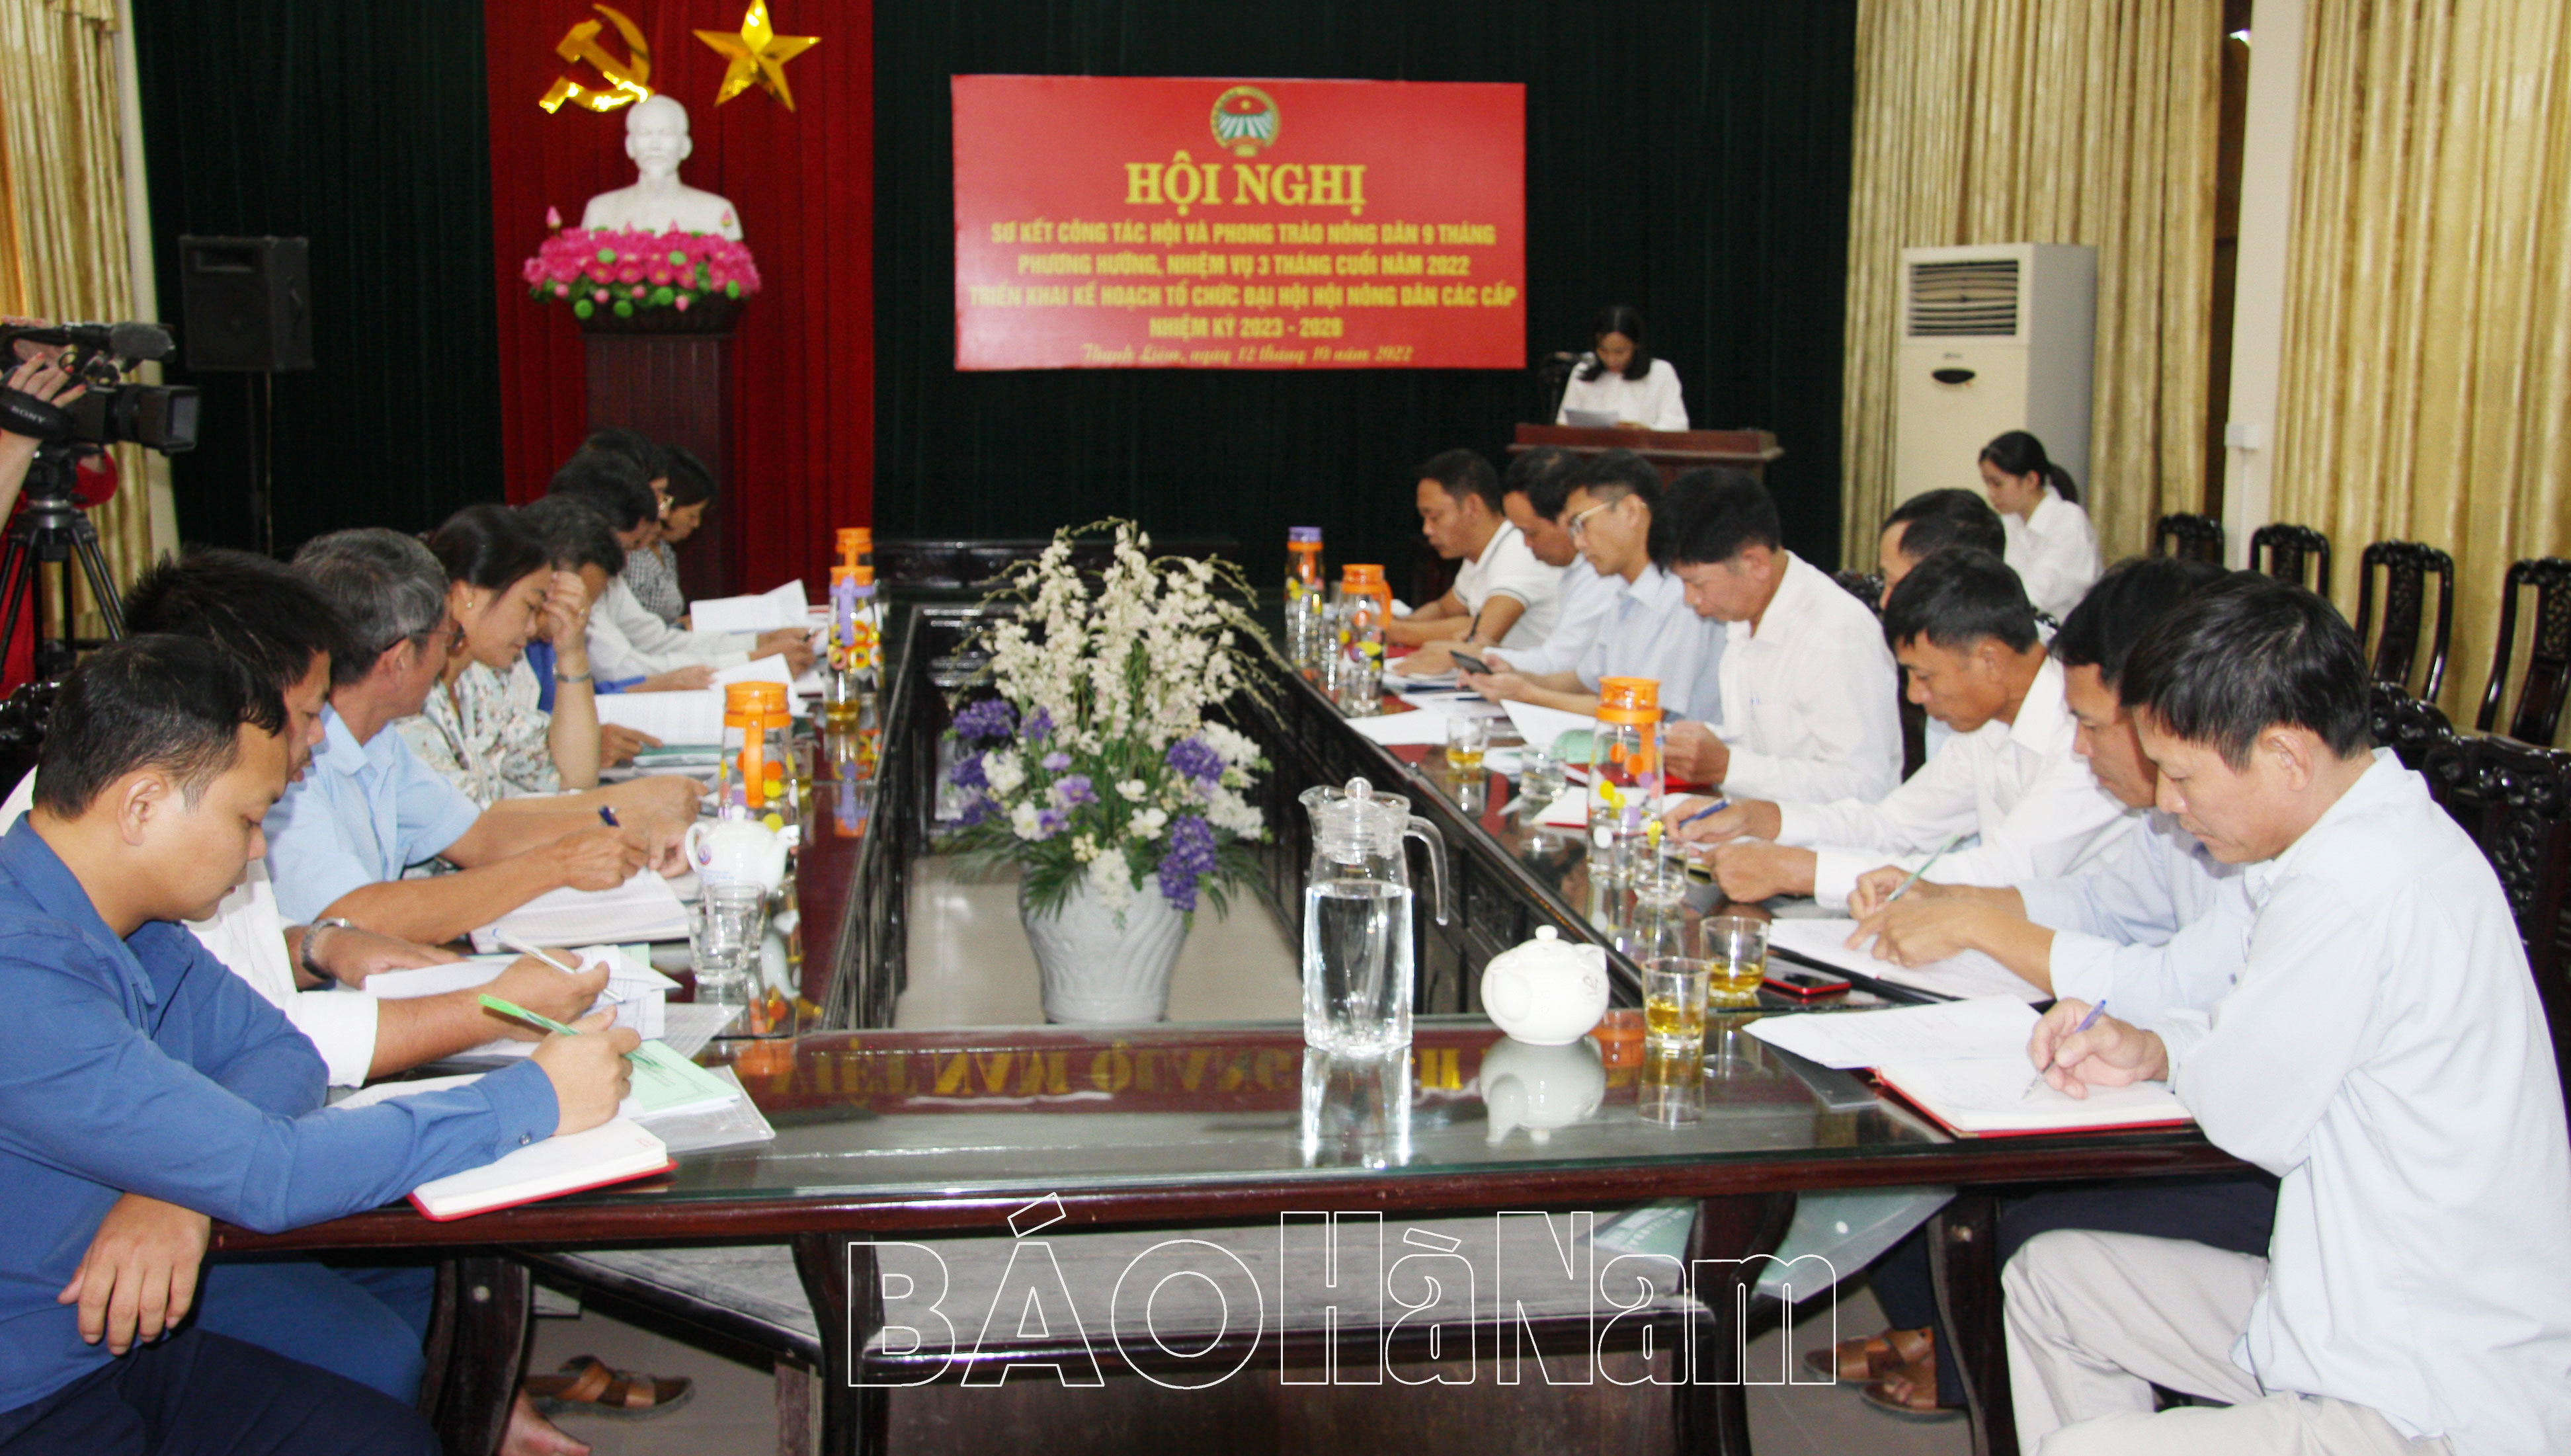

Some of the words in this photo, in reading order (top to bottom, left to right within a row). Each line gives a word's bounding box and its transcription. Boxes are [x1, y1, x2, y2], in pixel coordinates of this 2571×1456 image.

[1125, 149, 1223, 217] HỘI
[1233, 163, 1368, 217] NGHỊ
[992, 220, 1016, 243] SƠ
[1020, 216, 1054, 243] KẾT
[1057, 218, 1108, 243] CÔNG
[1112, 218, 1147, 243] TÁC
[1150, 218, 1182, 248] HỘI
[1185, 219, 1210, 243] VÀ
[1213, 222, 1274, 244] PHONG
[1278, 220, 1325, 244] TRÀO
[1327, 220, 1378, 244] NÔNG
[1381, 220, 1419, 244] DÂN
[1422, 223, 1435, 245] 9
[1438, 220, 1496, 245] THÁNG
[1018, 251, 1092, 275] PHƯƠNG
[1095, 249, 1165, 276] HƯỚNG,
[1167, 250, 1227, 279] NHIỆM
[1230, 254, 1254, 279] VỤ
[1257, 255, 1270, 275] 3
[1273, 251, 1332, 275] THÁNG
[1335, 248, 1378, 275] CUỐI
[1381, 251, 1424, 275] NĂM
[1426, 255, 1471, 276] 2022
[969, 280, 1022, 306] TRIỂN
[1026, 286, 1069, 306] KHAI
[1072, 280, 1098, 306] KẾ
[1100, 286, 1162, 311] HOẠCH
[1164, 278, 1188, 306] TỔ
[1191, 281, 1241, 306] CHỨC
[1243, 286, 1275, 311] ĐẠI
[1278, 282, 1309, 311] HỘI
[1312, 282, 1344, 311] HỘI
[1346, 282, 1397, 306] NÔNG
[1400, 282, 1438, 306] DÂN
[1442, 282, 1478, 306] CÁC
[1481, 280, 1517, 306] CẤP
[1149, 312, 1209, 343] NHIỆM
[1239, 316, 1285, 339] 2023
[1298, 316, 1344, 339] 2028
[1081, 342, 1136, 363] Thanh
[1190, 348, 1233, 366] ngày
[1238, 345, 1256, 363] 12
[1258, 343, 1307, 366] tháng
[1333, 348, 1371, 363] năm
[1374, 344, 1414, 363] 2022
[10, 405, 47, 424] SONY
